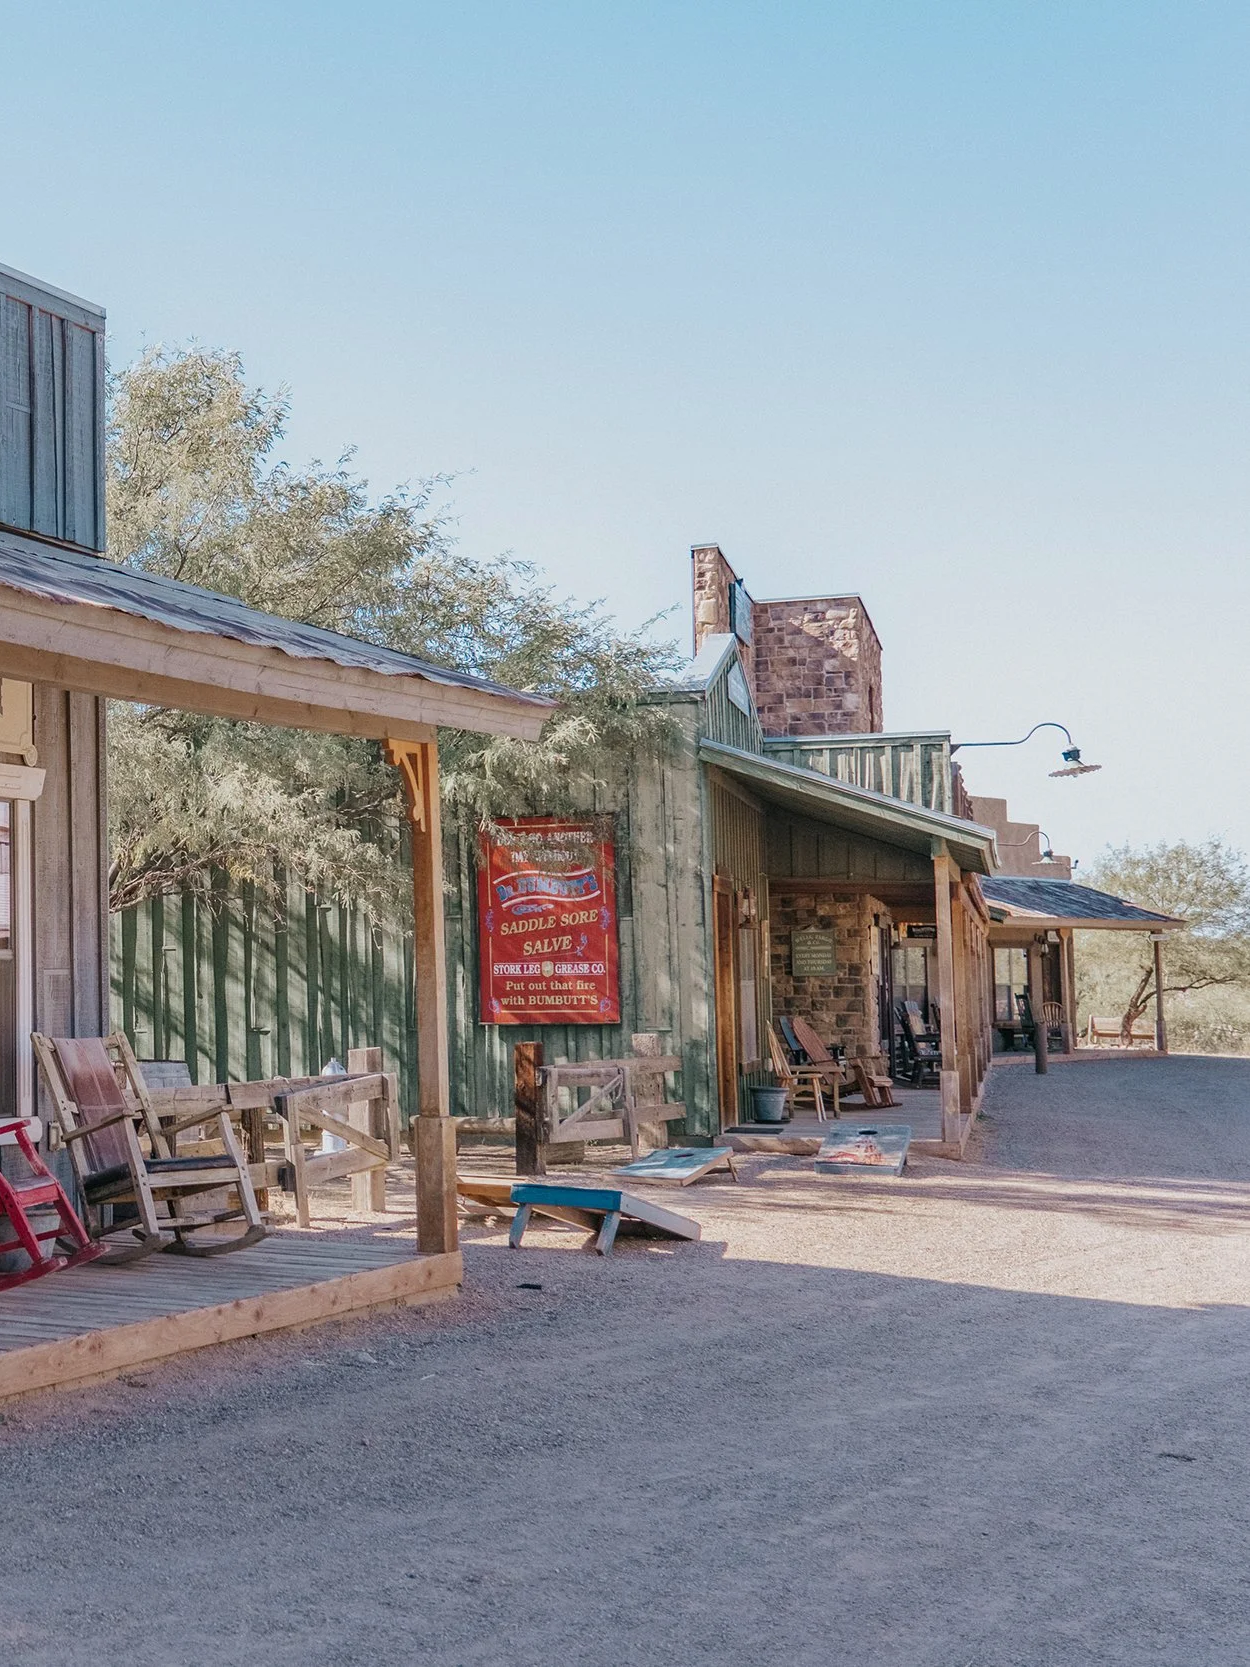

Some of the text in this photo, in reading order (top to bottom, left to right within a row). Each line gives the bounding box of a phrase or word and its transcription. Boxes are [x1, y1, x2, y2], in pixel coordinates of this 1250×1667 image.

[500, 909, 599, 936] SADDLE SORE
[523, 935, 573, 956] SALVE
[493, 963, 606, 975] STORK LEG GREASE CO.
[505, 980, 596, 991] Put out that fire
[500, 995, 598, 1005] with BUMBUTT'S
